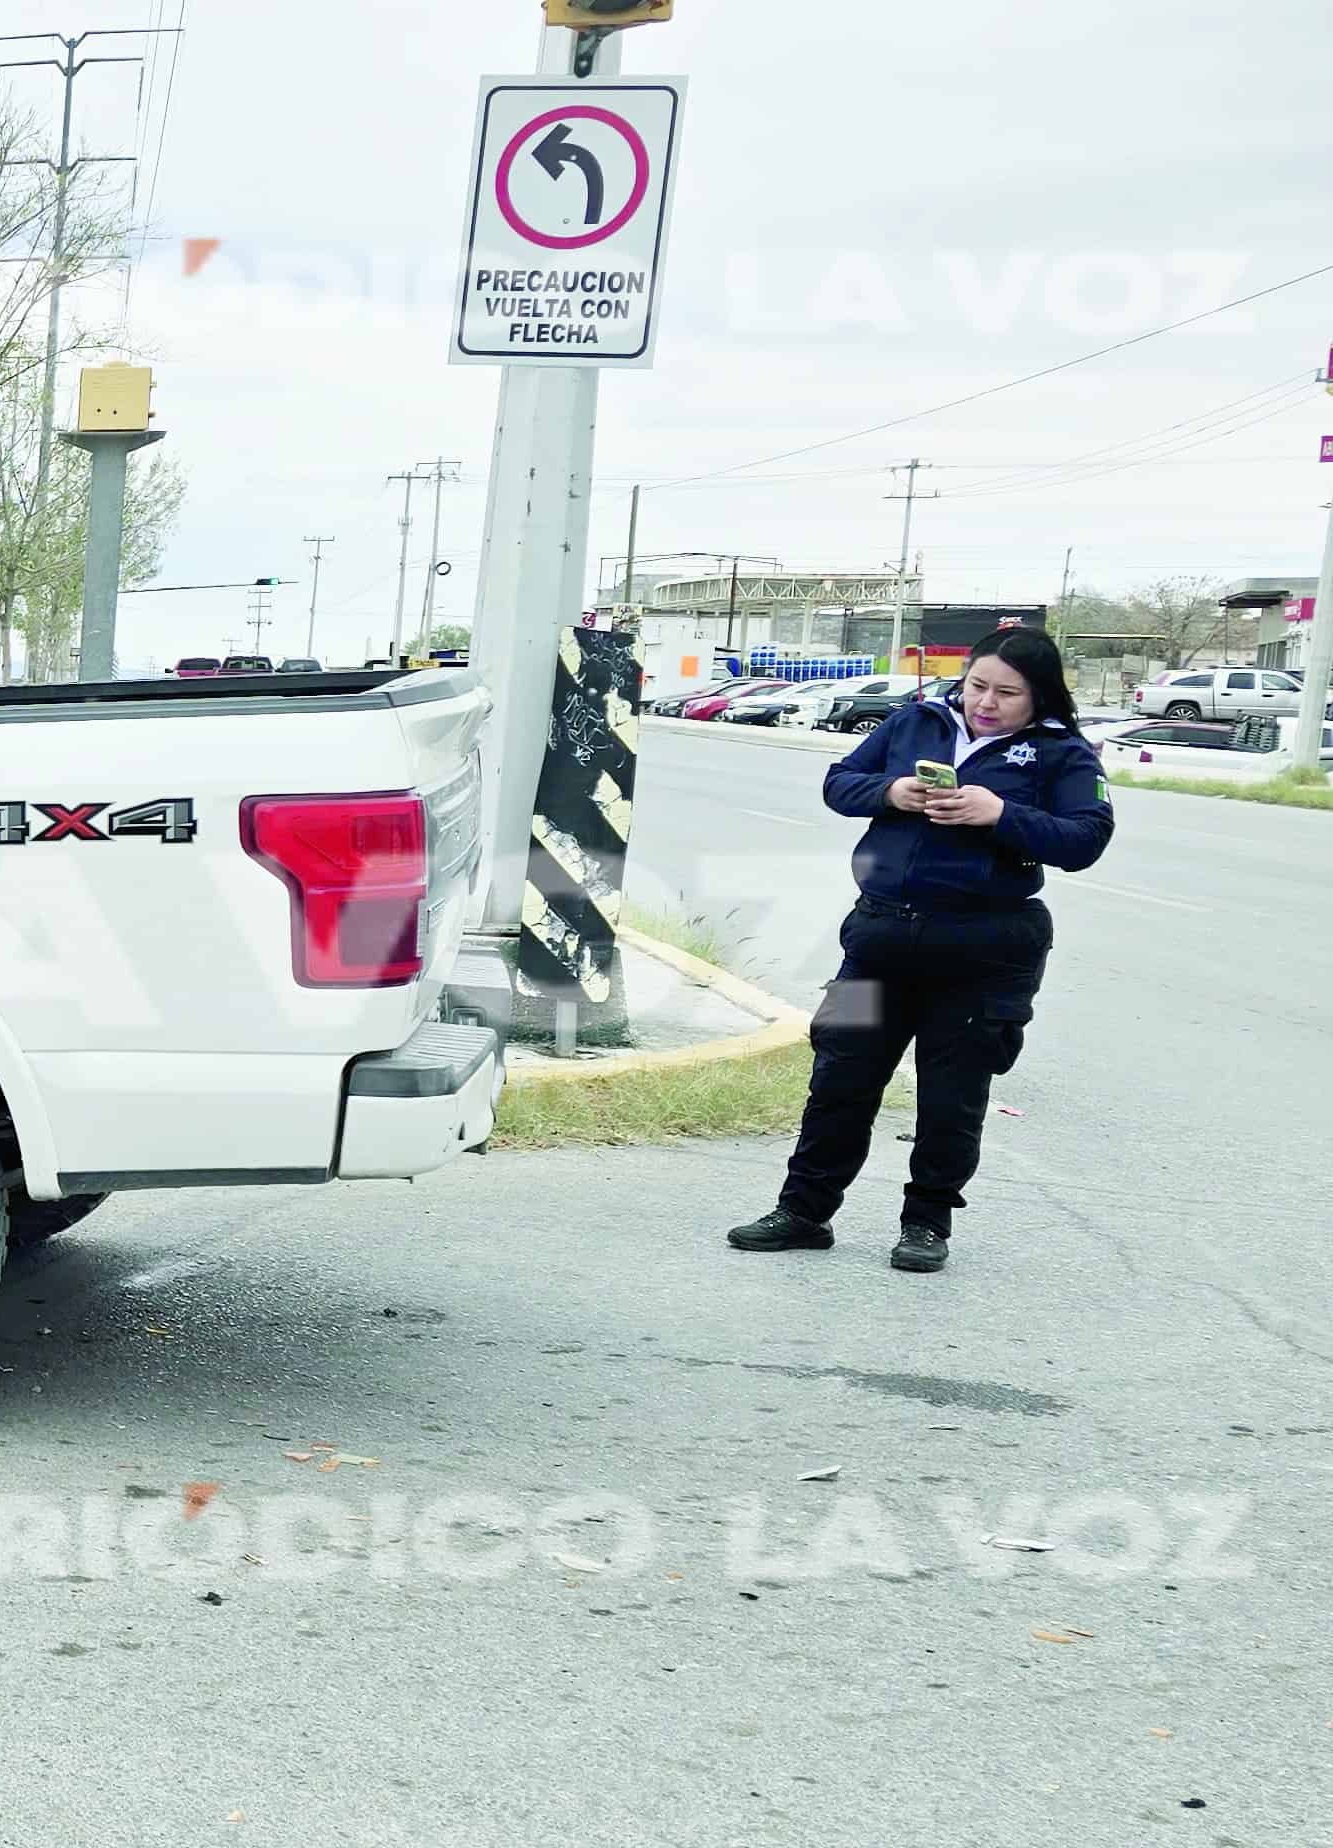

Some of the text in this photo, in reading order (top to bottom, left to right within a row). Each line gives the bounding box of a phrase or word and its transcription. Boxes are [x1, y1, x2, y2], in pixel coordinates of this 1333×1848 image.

[476, 270, 645, 293] PRECAUCION
[485, 298, 629, 319] VUELTA CON
[509, 323, 598, 343] FLECHA
